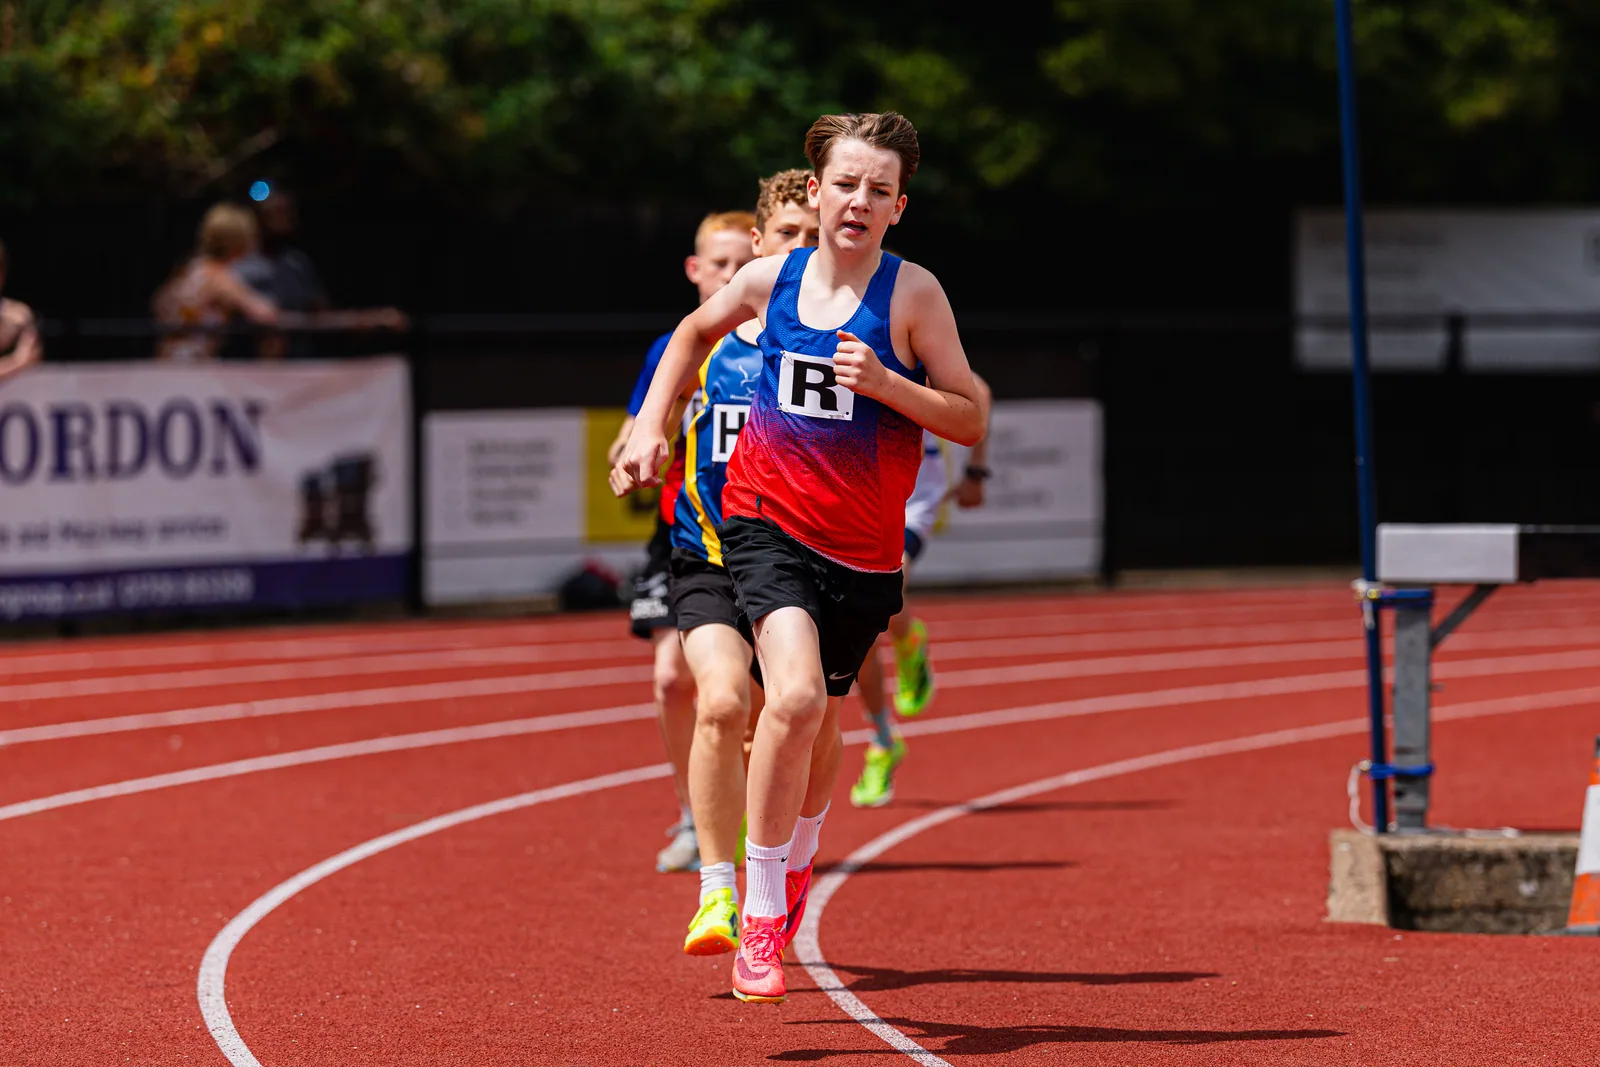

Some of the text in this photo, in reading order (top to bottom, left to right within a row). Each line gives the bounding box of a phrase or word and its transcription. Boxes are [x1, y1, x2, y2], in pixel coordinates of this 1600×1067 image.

[791, 360, 838, 412] R
[0, 397, 264, 485] ORDON
[719, 411, 745, 454] H
